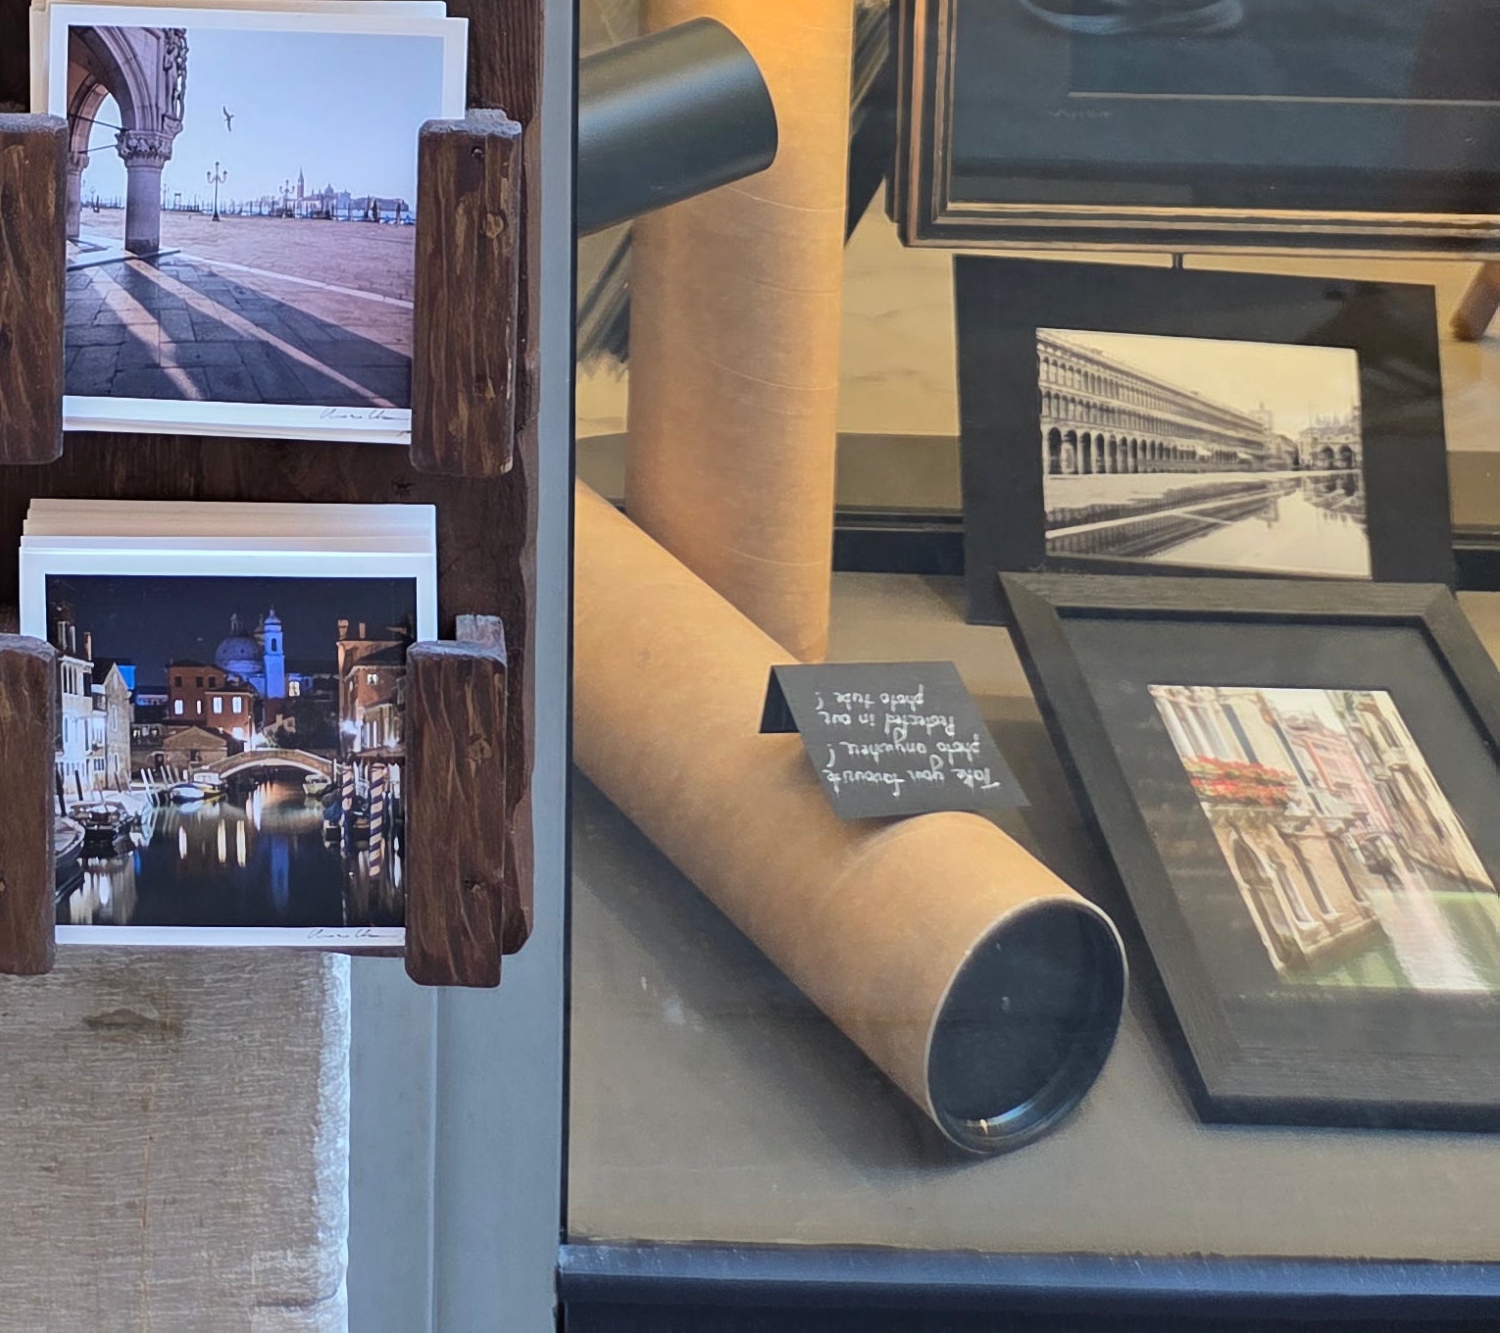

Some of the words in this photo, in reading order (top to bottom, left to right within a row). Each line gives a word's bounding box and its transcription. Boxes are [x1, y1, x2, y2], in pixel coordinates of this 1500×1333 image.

[832, 691, 875, 710] tube
[878, 683, 925, 712] photo
[817, 710, 852, 726] our
[858, 712, 876, 726] in
[936, 733, 981, 764] photo
[907, 753, 945, 782] your
[950, 767, 1002, 789] Take
[821, 768, 905, 797] favourite
